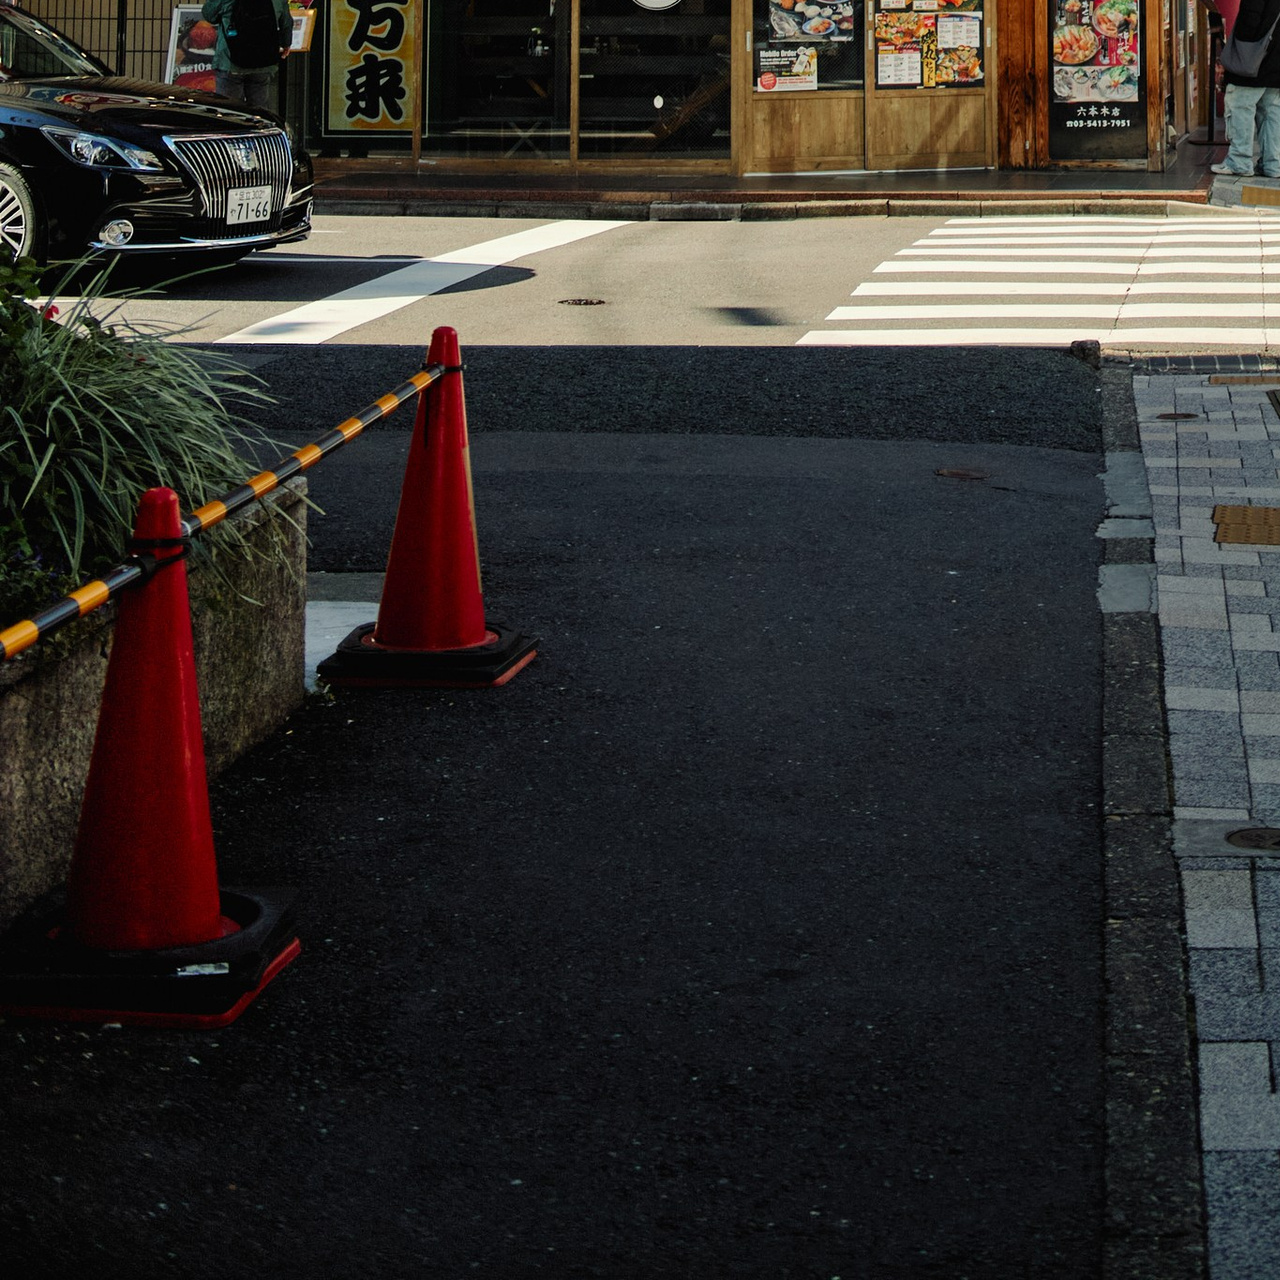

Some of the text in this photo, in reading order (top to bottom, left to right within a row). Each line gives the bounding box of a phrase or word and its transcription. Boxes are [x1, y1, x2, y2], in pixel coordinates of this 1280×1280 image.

[1076, 105, 1121, 117] 六本木店
[1073, 119, 1131, 127] 03-5413-7951
[237, 200, 269, 220] 71-66
